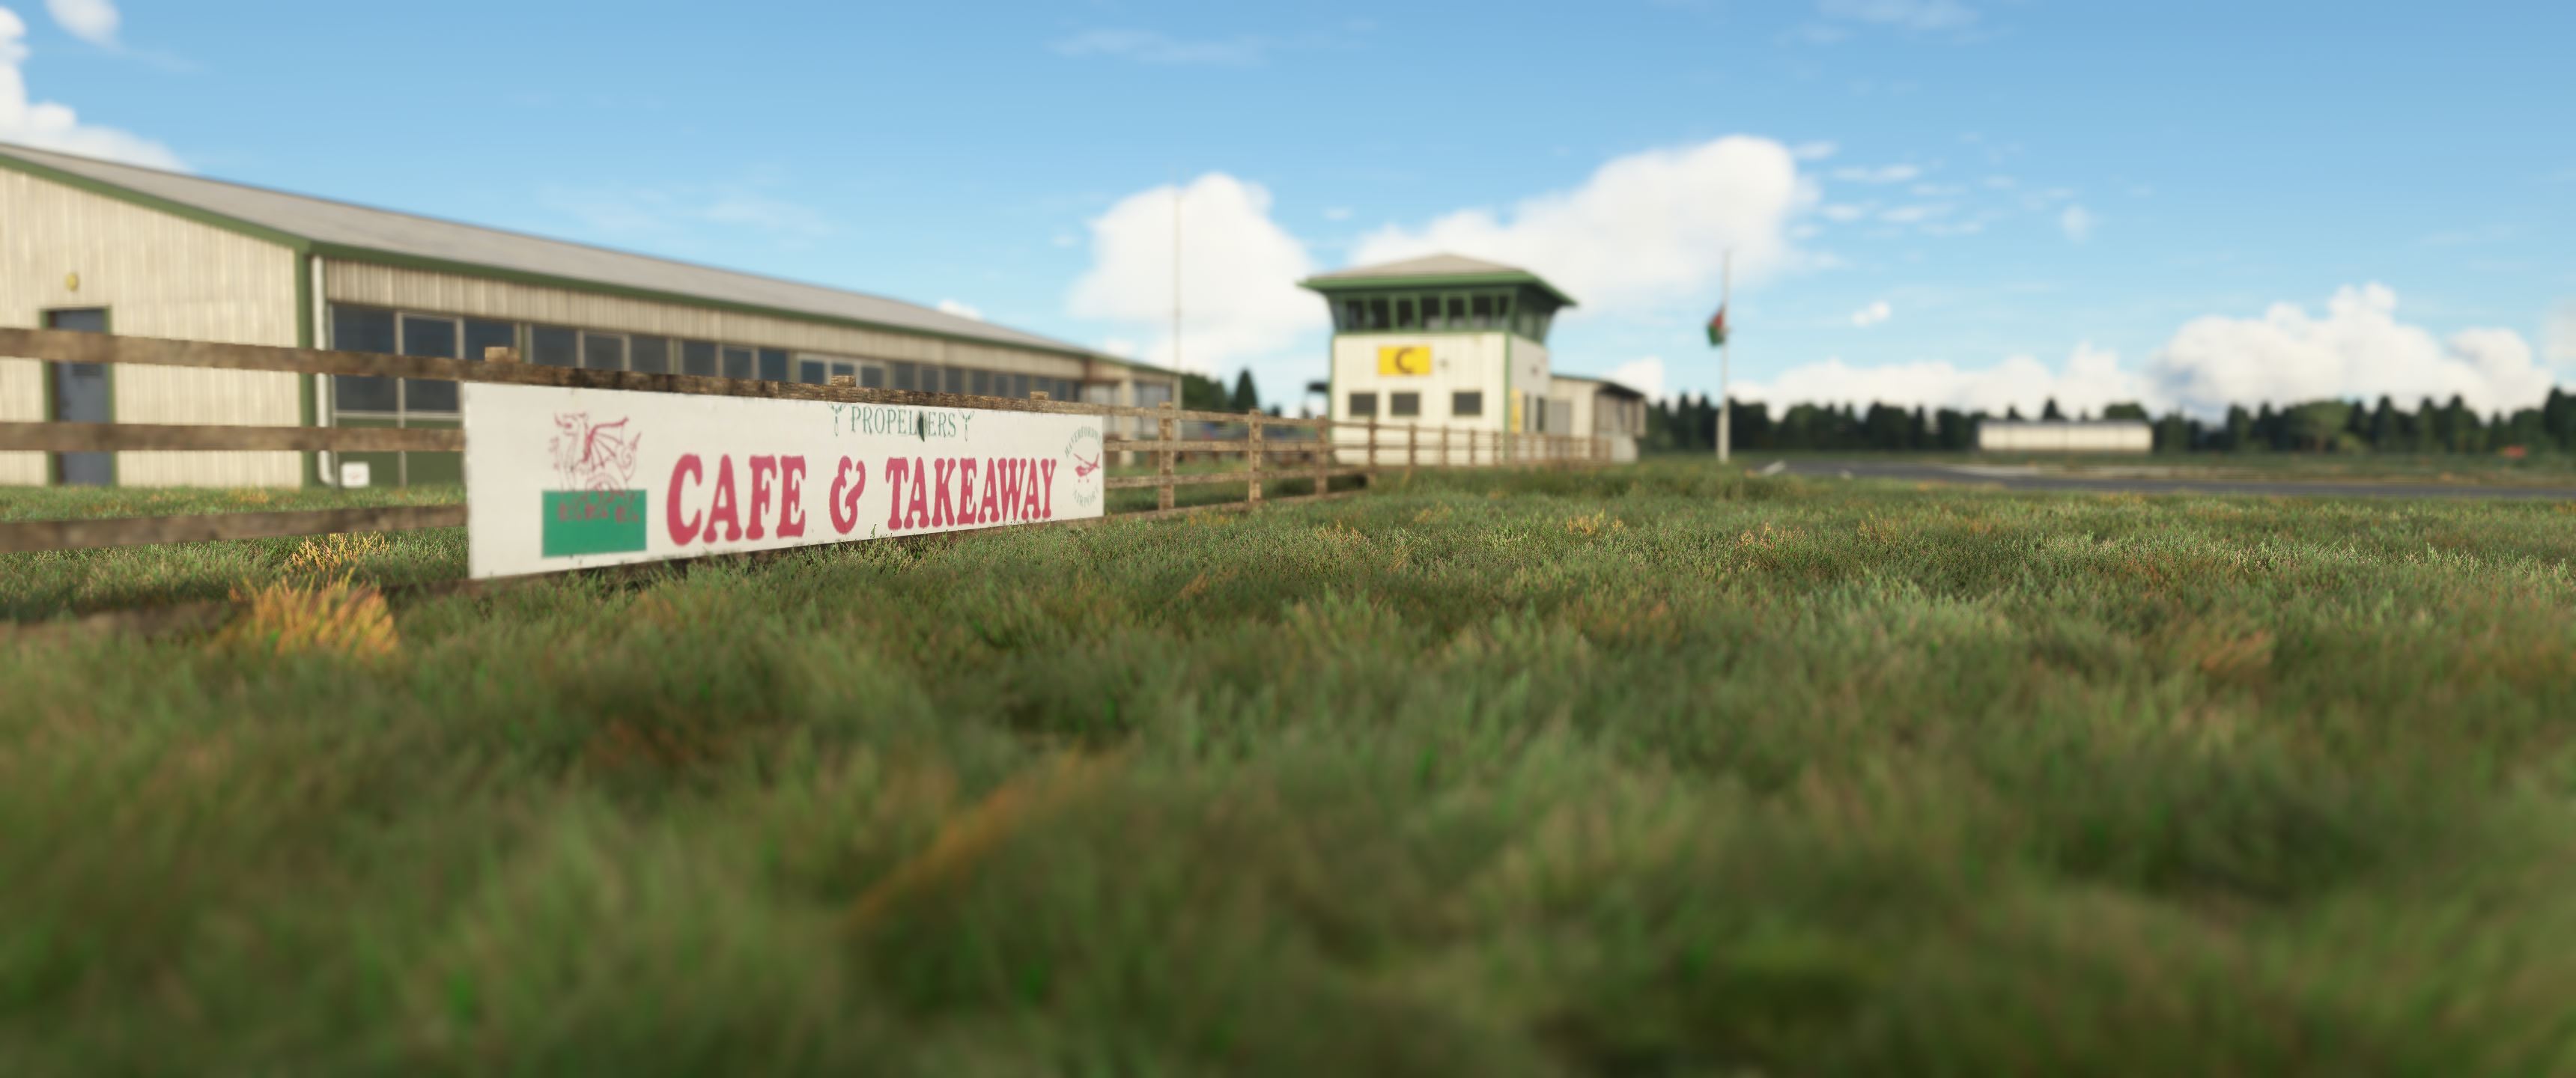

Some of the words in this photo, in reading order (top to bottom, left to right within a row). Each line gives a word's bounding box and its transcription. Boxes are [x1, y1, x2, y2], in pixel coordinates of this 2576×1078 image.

[1395, 346, 1415, 375] C
[851, 405, 956, 437] PROPELERS
[666, 454, 806, 546] CAFE
[829, 455, 866, 534] &
[885, 457, 1056, 531] TAKEAWAY
